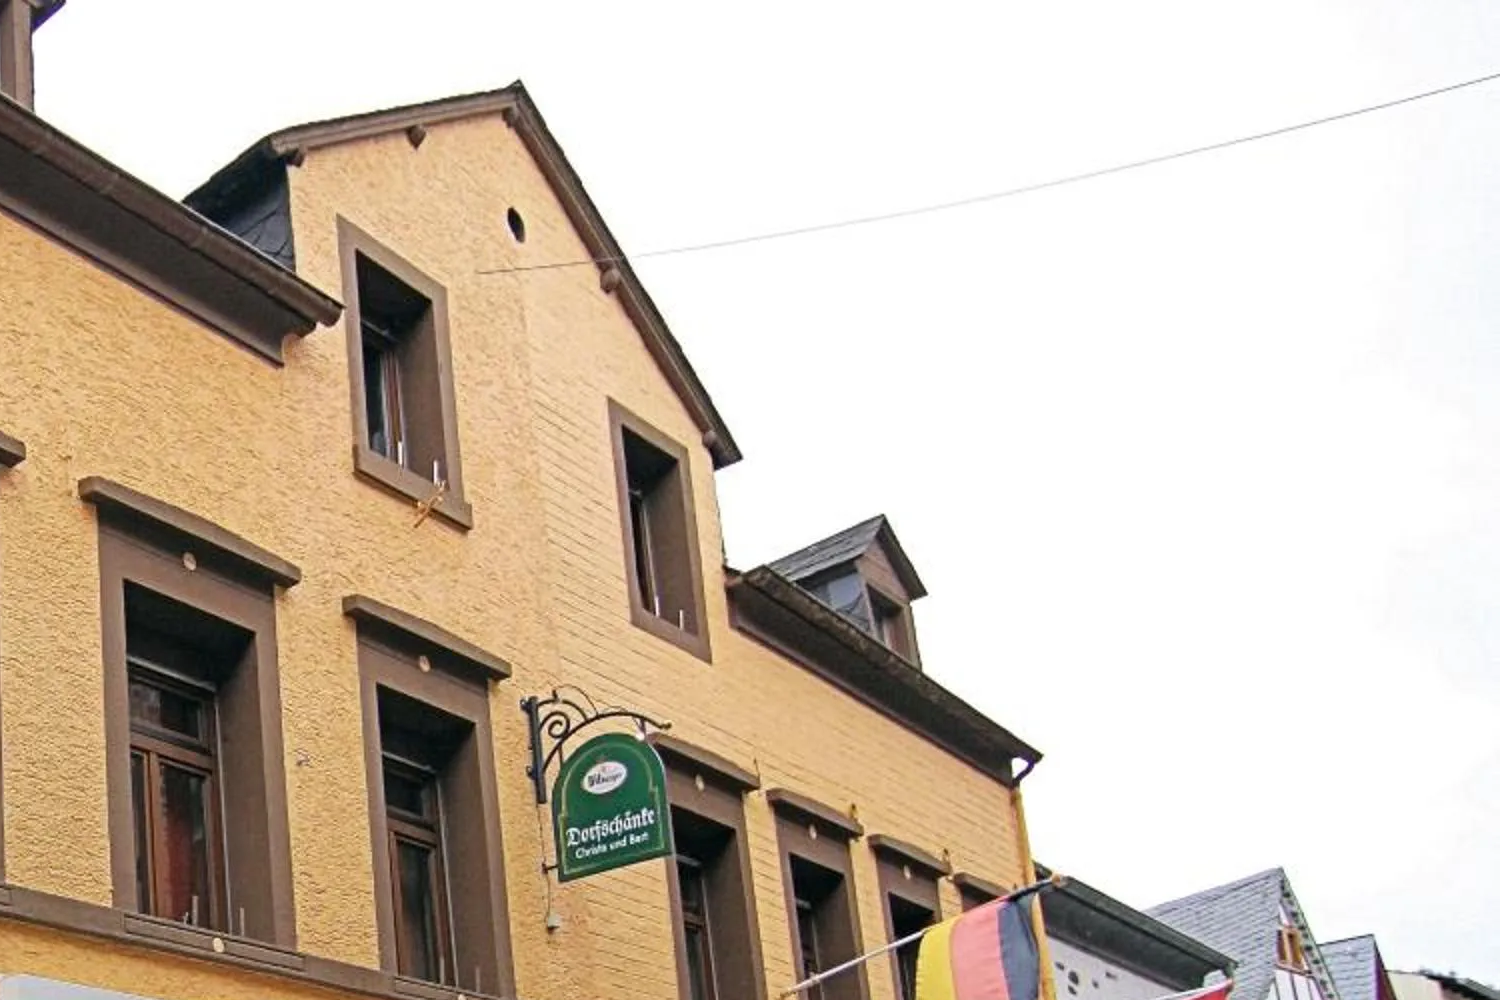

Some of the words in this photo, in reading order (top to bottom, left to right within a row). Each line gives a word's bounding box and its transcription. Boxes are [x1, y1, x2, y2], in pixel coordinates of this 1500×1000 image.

[566, 807, 655, 847] Dorfschänke
[575, 843, 607, 859] Christa
[609, 836, 627, 851] und
